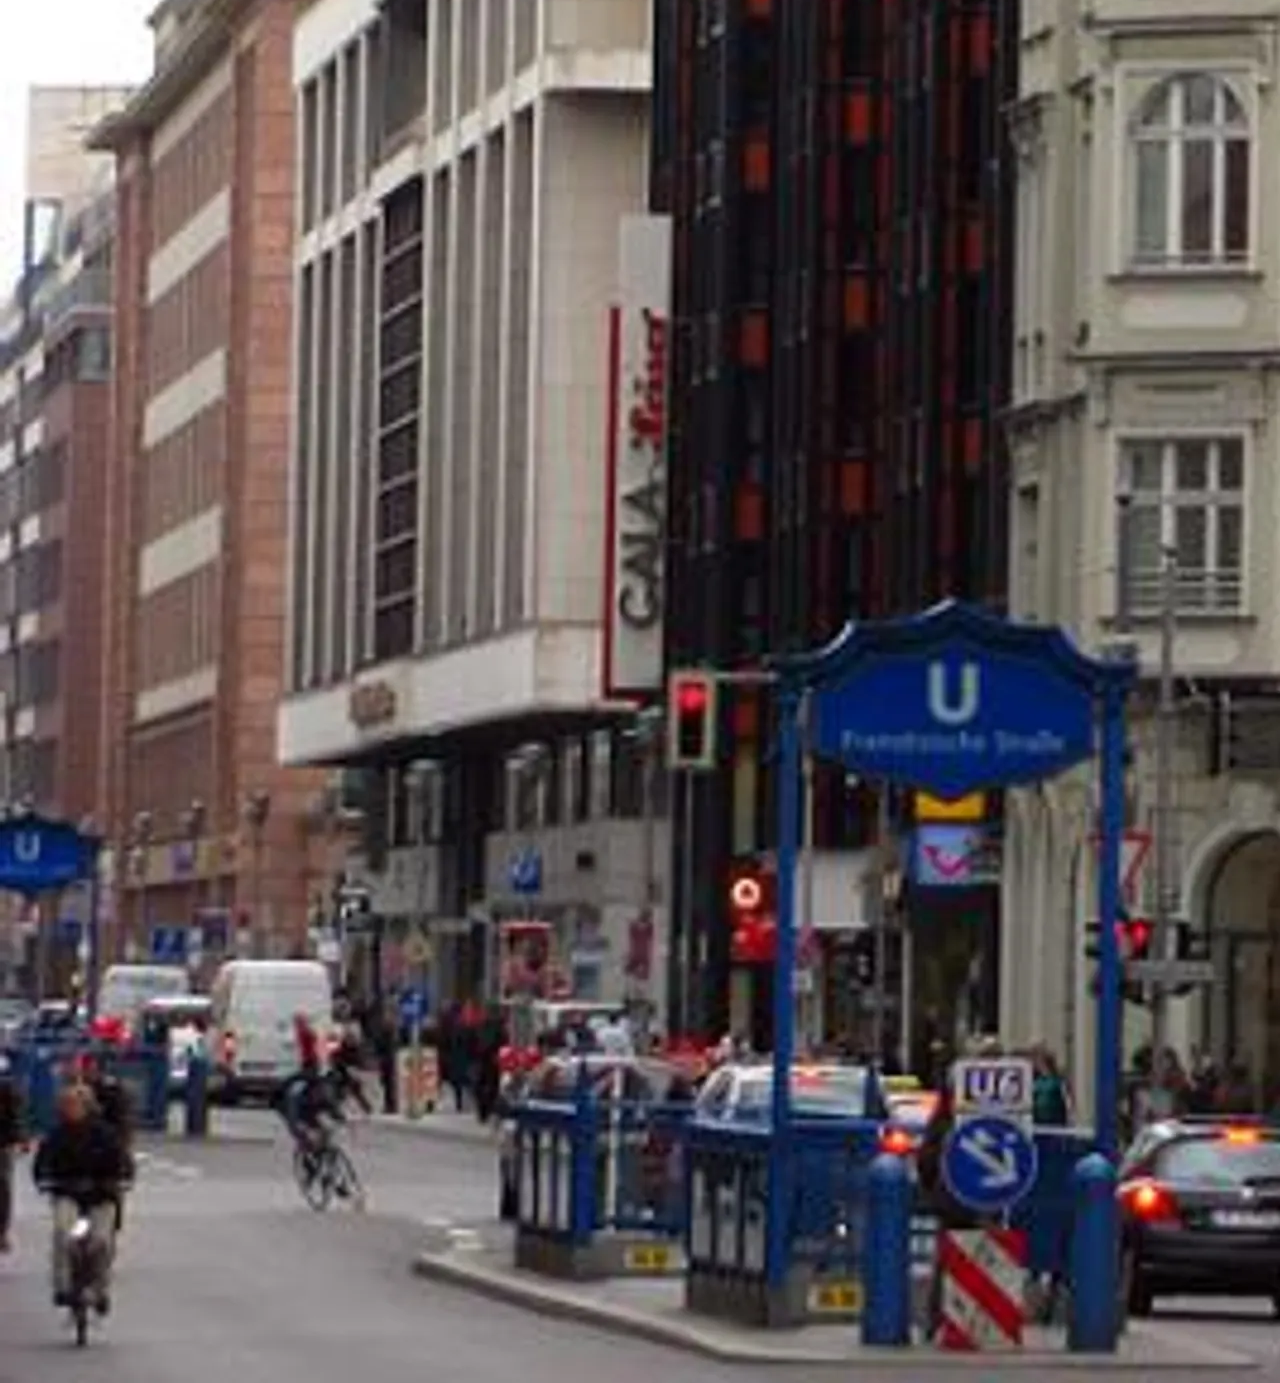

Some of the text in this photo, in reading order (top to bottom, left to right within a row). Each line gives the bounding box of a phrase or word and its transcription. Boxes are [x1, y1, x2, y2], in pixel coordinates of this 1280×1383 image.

[928, 661, 980, 725] U
[14, 830, 40, 863] U
[965, 1067, 1023, 1102] U6
